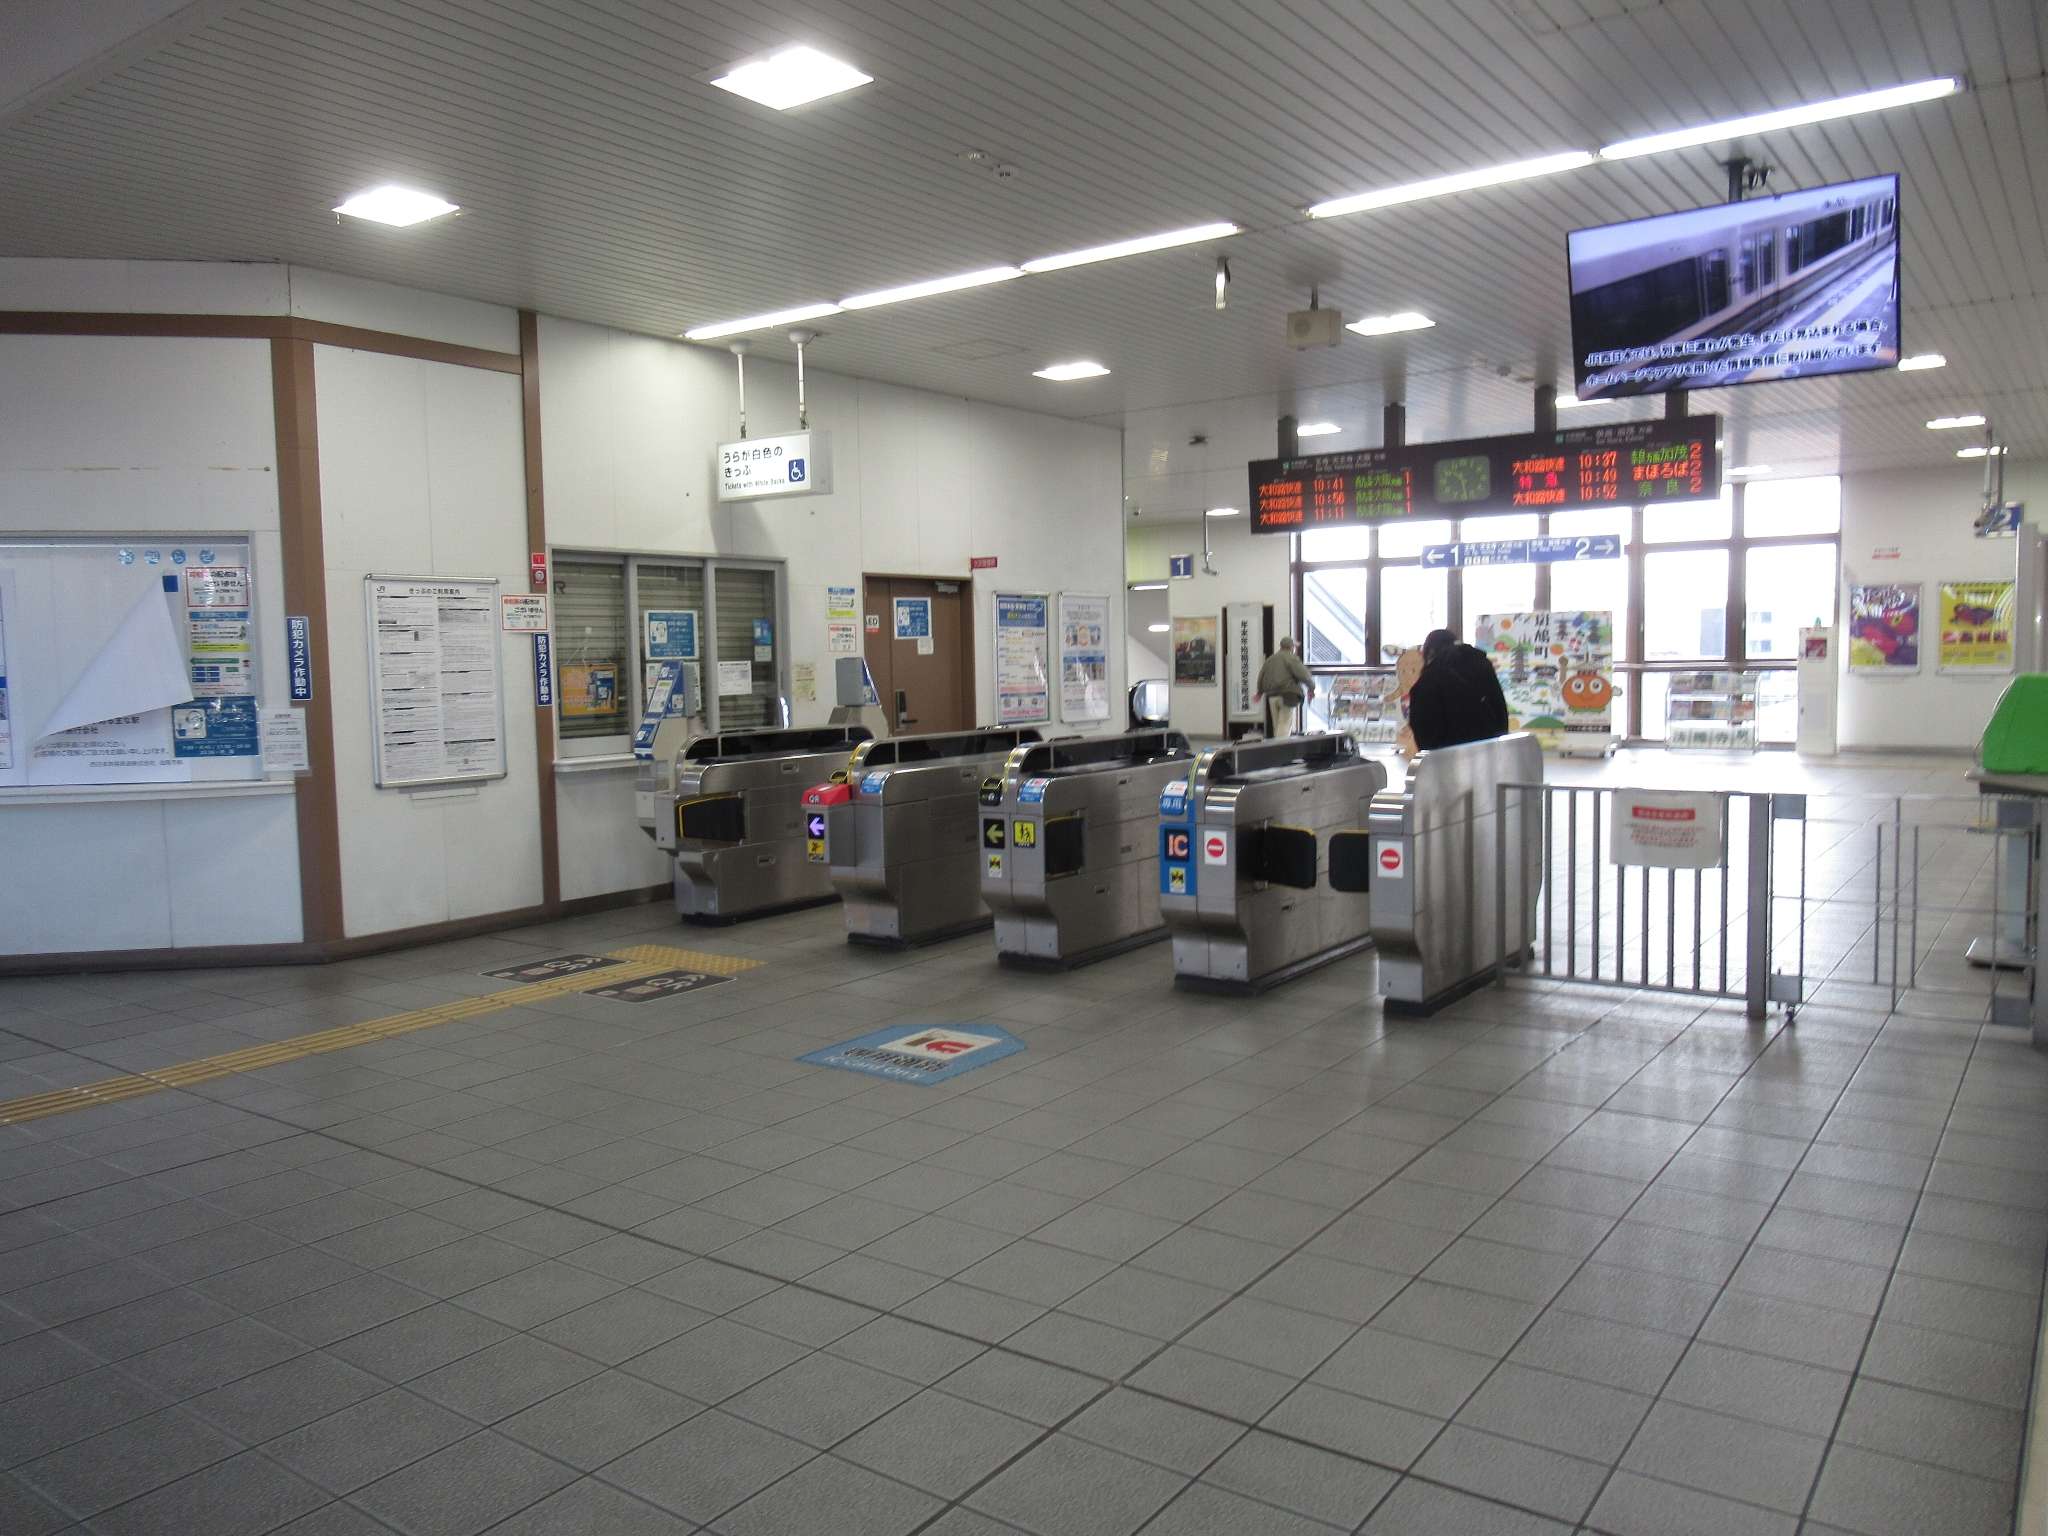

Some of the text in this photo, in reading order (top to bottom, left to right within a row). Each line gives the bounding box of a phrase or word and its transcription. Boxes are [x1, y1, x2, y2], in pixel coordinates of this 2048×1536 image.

[723, 446, 783, 464] うらが白色の
[1578, 451, 1617, 467] 10:37
[1689, 442, 1703, 459] 2
[1313, 475, 1344, 492] 10:41
[1404, 470, 1412, 483] 1
[1519, 460, 1702, 489] 特急 10:49 まほろば 2
[1405, 486, 1412, 499] 1
[1580, 485, 1617, 501] 10:52
[1639, 480, 1680, 497] 奈良
[1689, 477, 1702, 494] 2
[1315, 506, 1345, 521] 11:11
[1405, 499, 1413, 513] 1
[1451, 545, 1460, 566] 1
[1574, 537, 1591, 561] 2
[1177, 558, 1185, 576] 1
[291, 618, 307, 697] 防犯カメラ作動中
[537, 635, 550, 702] 防犯カメラ作動中
[1167, 833, 1189, 857] IC
